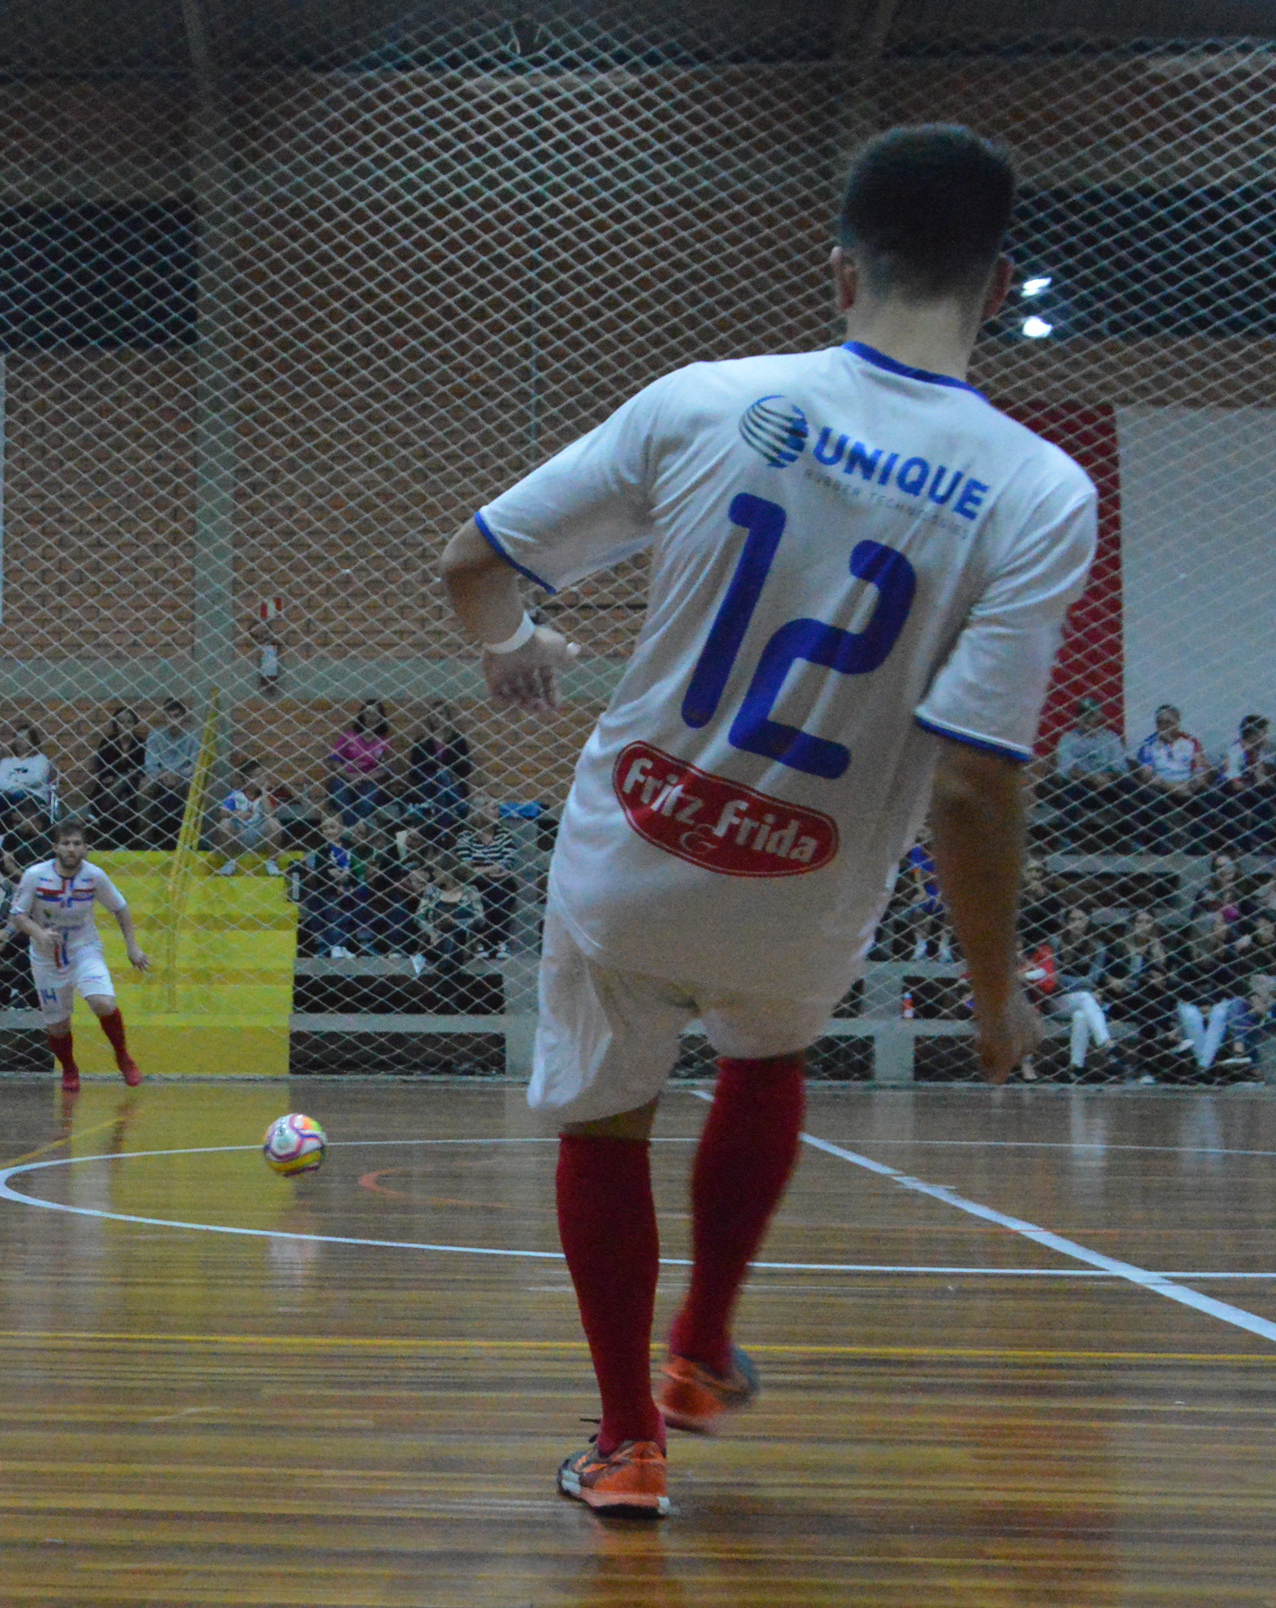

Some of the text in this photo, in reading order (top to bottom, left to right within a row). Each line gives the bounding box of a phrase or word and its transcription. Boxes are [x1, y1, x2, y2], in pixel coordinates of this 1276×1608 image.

[812, 426, 990, 521] UNIQUE
[681, 492, 917, 780] 12
[623, 757, 705, 826] Fritz
[713, 799, 819, 864] Frida
